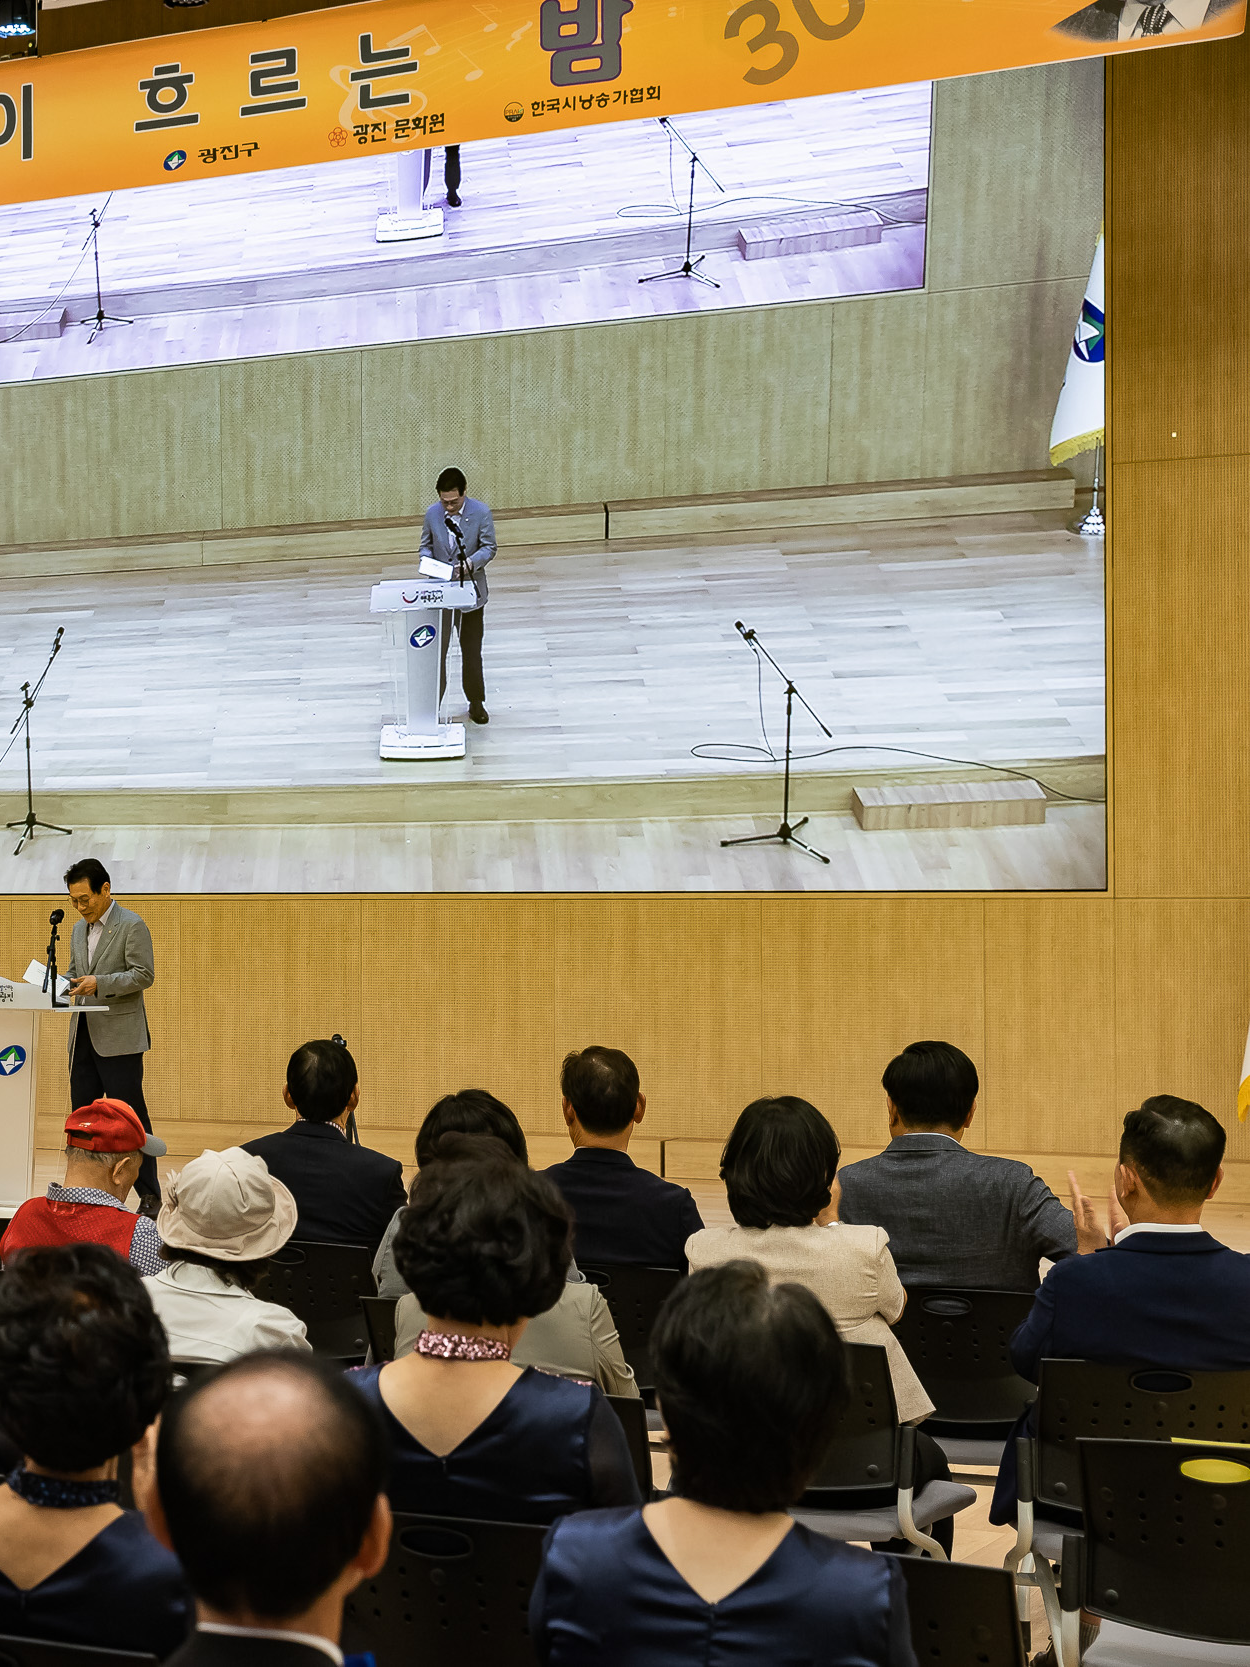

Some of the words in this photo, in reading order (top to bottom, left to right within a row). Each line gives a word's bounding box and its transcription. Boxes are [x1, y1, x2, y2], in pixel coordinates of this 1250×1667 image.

[539, 0, 634, 86] 밤
[531, 85, 661, 117] 한국시낭송가협회
[353, 121, 386, 145] 광진
[393, 113, 444, 139] 문화원
[198, 142, 260, 164] 광진구
